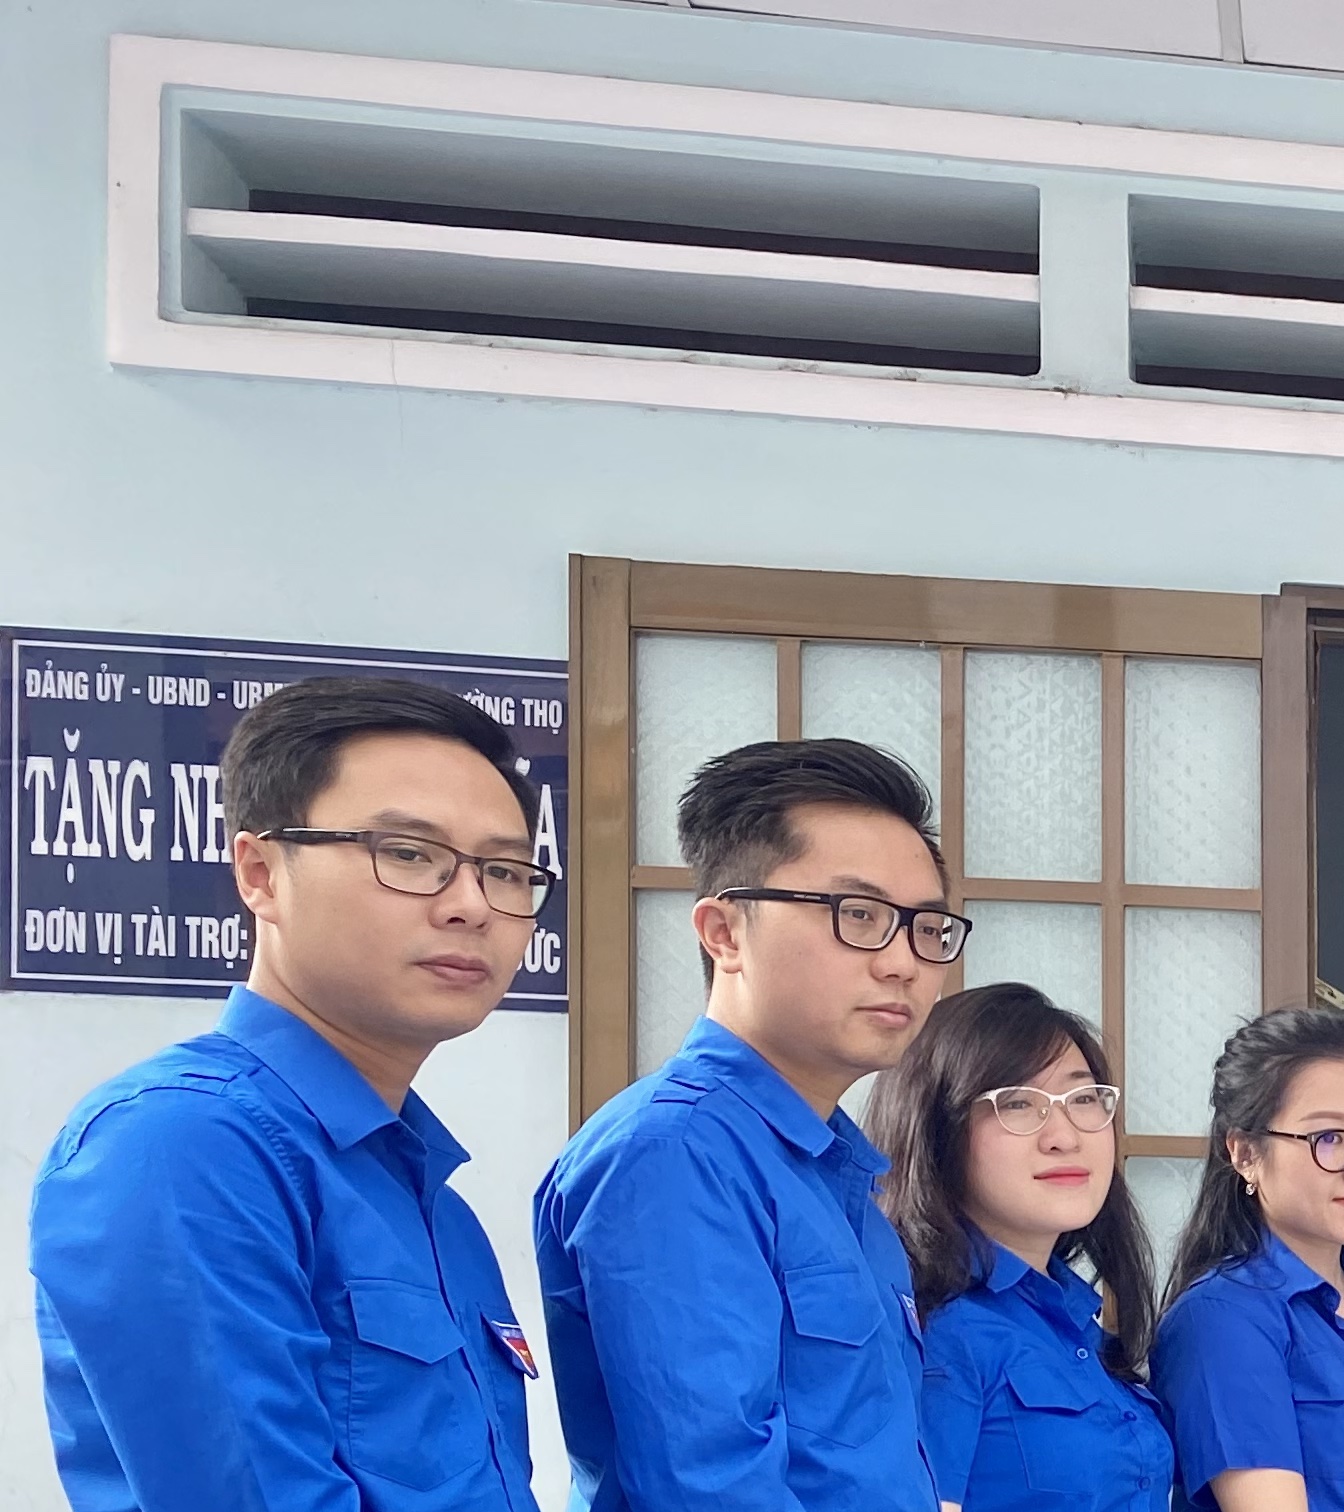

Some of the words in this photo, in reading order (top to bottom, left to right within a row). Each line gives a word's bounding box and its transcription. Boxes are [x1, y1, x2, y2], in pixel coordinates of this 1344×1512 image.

[25, 660, 89, 700] ĐẢNG
[96, 663, 125, 702] ỦY
[148, 675, 210, 707] UBND
[521, 698, 563, 735] THỌ
[24, 727, 155, 884] TẶNG
[170, 763, 234, 864] NH
[25, 909, 86, 953] ĐƠN
[95, 912, 122, 965] VỊ
[131, 906, 176, 957] TÀI
[184, 914, 248, 969] TRỢ:
[522, 923, 561, 974] ỨC
